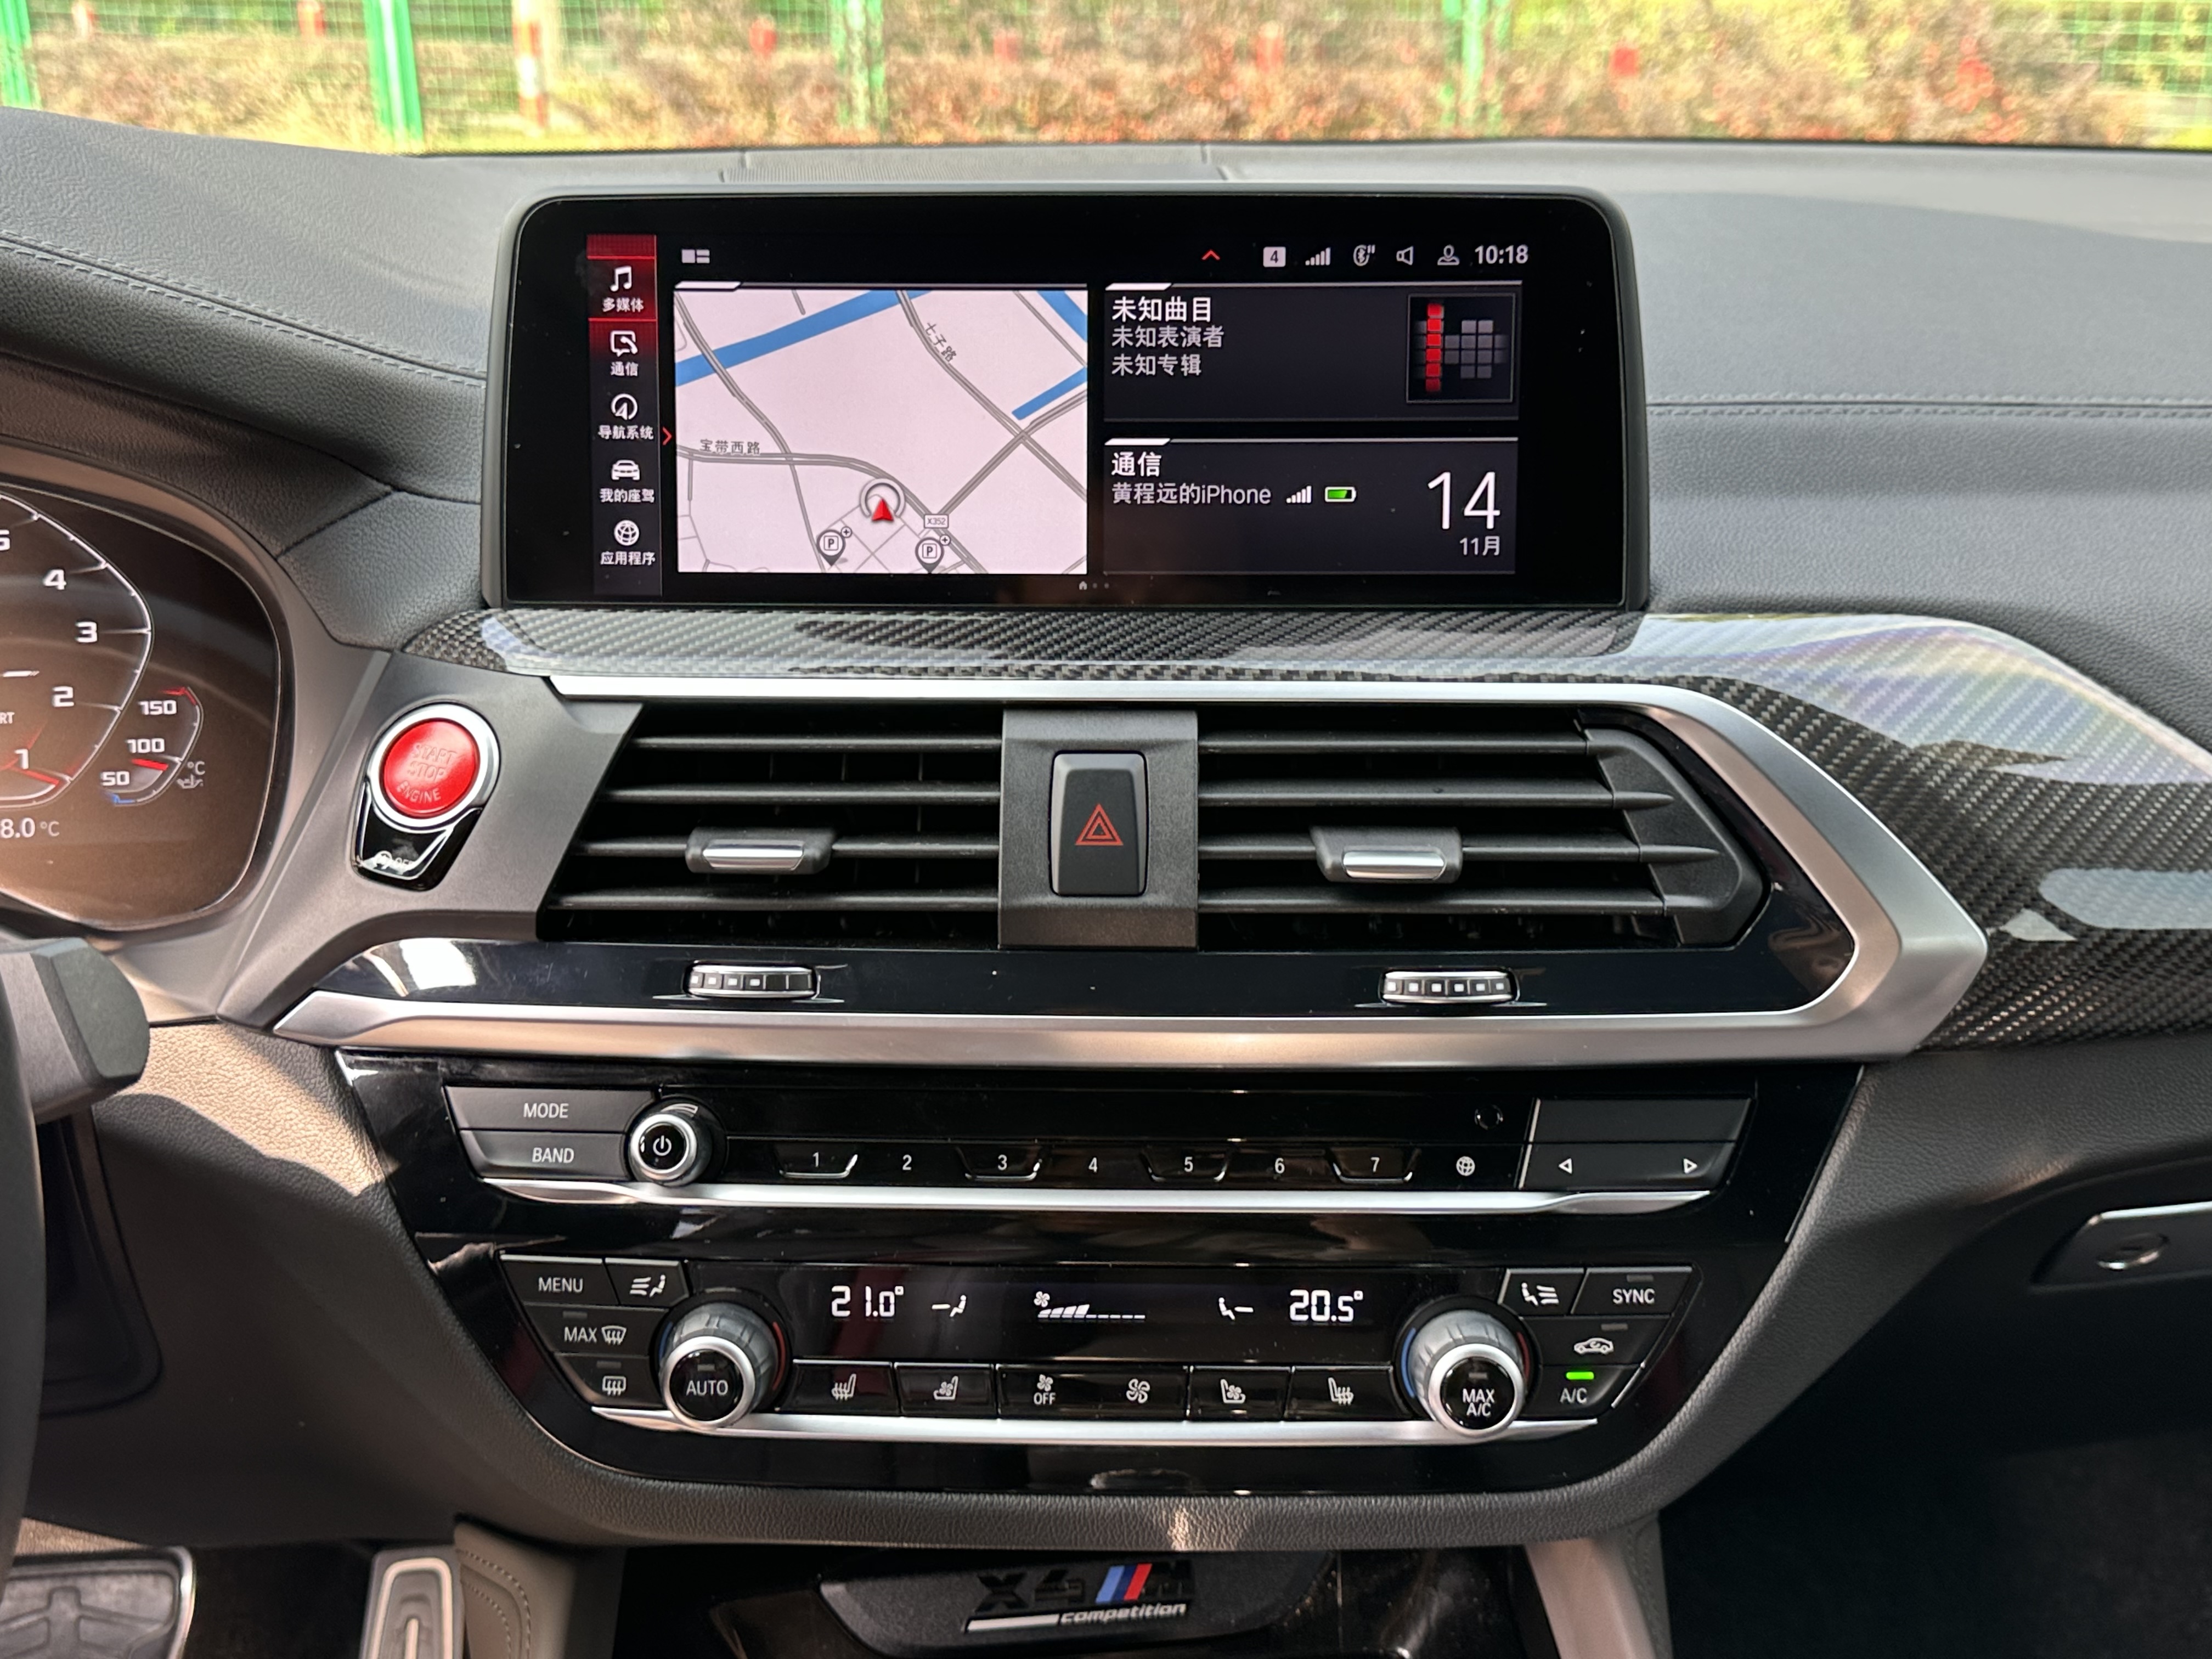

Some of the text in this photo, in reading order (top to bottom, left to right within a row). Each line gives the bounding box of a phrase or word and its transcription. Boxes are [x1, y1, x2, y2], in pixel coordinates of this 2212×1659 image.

[1270, 250, 1278, 263] 4
[1475, 245, 1528, 264] 10:18
[603, 297, 644, 312] 多媒体
[1112, 296, 1211, 322] 未知曲目
[925, 322, 956, 363] 七子路
[1111, 325, 1224, 348] 未知表演者
[611, 361, 639, 376] 通信
[1111, 353, 1201, 376] 未知专辑
[598, 425, 654, 440] 导航系统
[700, 439, 760, 455] 宝带西路
[1111, 452, 1162, 477] 通信
[600, 488, 654, 503] 我的座驾
[1111, 482, 1271, 504] 黄程远的iPhone
[1428, 472, 1500, 529] 14
[1459, 535, 1500, 556] 11月
[600, 551, 656, 566] 应用程序
[43, 569, 67, 590] 4
[76, 622, 98, 643] 3
[53, 686, 75, 707] 2
[139, 699, 177, 715] 150
[127, 738, 165, 753] 100
[412, 743, 458, 764] START
[14, 748, 29, 770] 1
[101, 771, 130, 786] 50
[408, 761, 447, 781] STOP
[397, 780, 442, 804] ENGINE
[523, 1103, 569, 1118] MODE
[532, 1147, 574, 1164] BAND
[813, 1152, 819, 1167] 1
[902, 1154, 912, 1170] 2
[998, 1154, 1007, 1171] 3
[1088, 1157, 1098, 1172] 4
[1184, 1156, 1193, 1172] 5
[1274, 1158, 1285, 1174] 6
[1371, 1157, 1380, 1172] 7
[538, 1277, 583, 1293] MENU
[1613, 1288, 1655, 1304] SYNC
[564, 1327, 597, 1342] MAX
[686, 1380, 729, 1396] AUTO
[1463, 1388, 1495, 1402] MAX
[1560, 1387, 1587, 1404] A/C
[1033, 1392, 1056, 1406] OFF
[1466, 1402, 1491, 1417] A/C
[1061, 1602, 1187, 1624] competition
